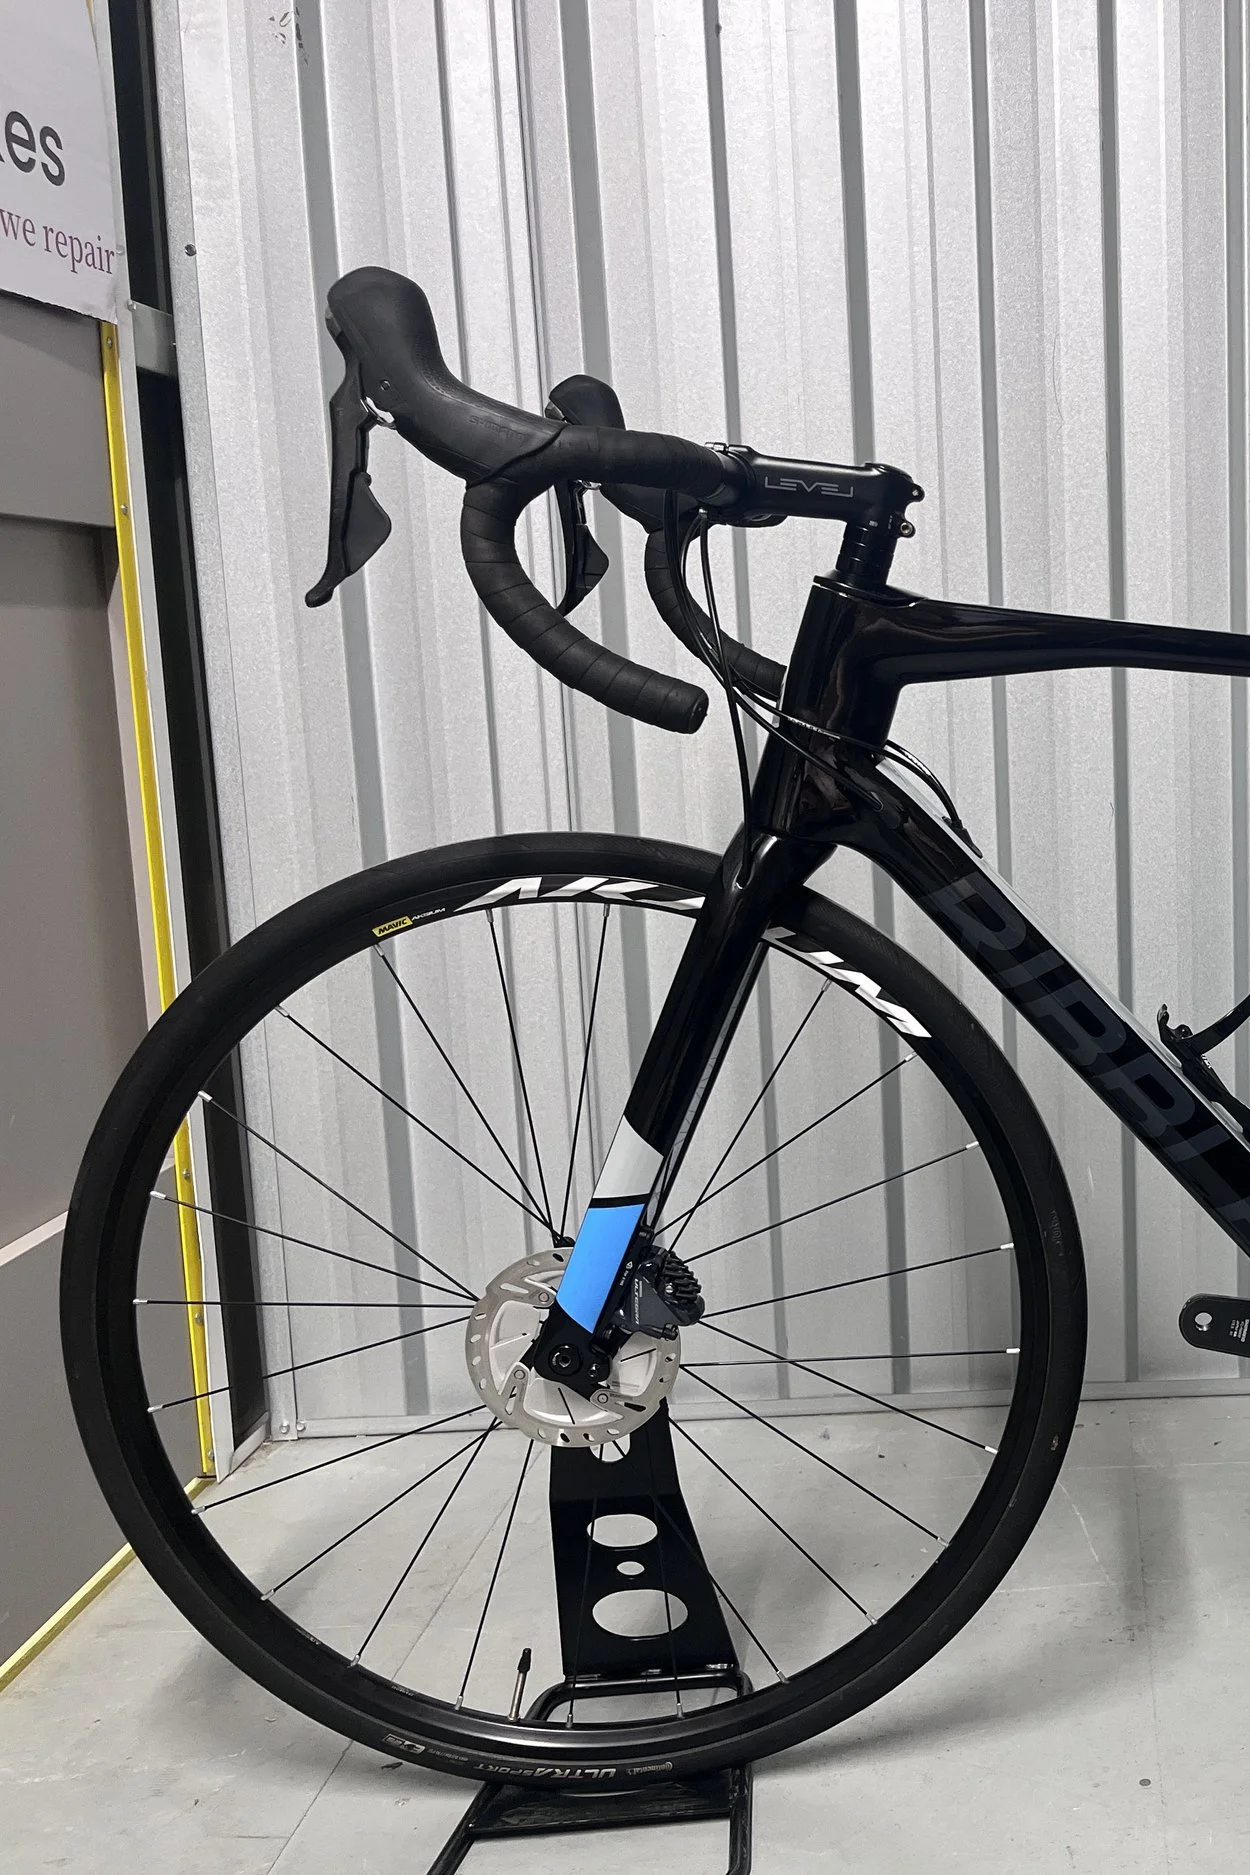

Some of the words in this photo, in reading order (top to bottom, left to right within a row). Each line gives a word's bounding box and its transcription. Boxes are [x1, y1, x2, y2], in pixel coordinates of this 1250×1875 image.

[0, 110, 66, 187] es
[0, 208, 36, 247] we
[42, 225, 115, 274] repair
[764, 476, 854, 498] LEVEL
[378, 918, 408, 935] MAVIC
[632, 1761, 674, 1776] Continental
